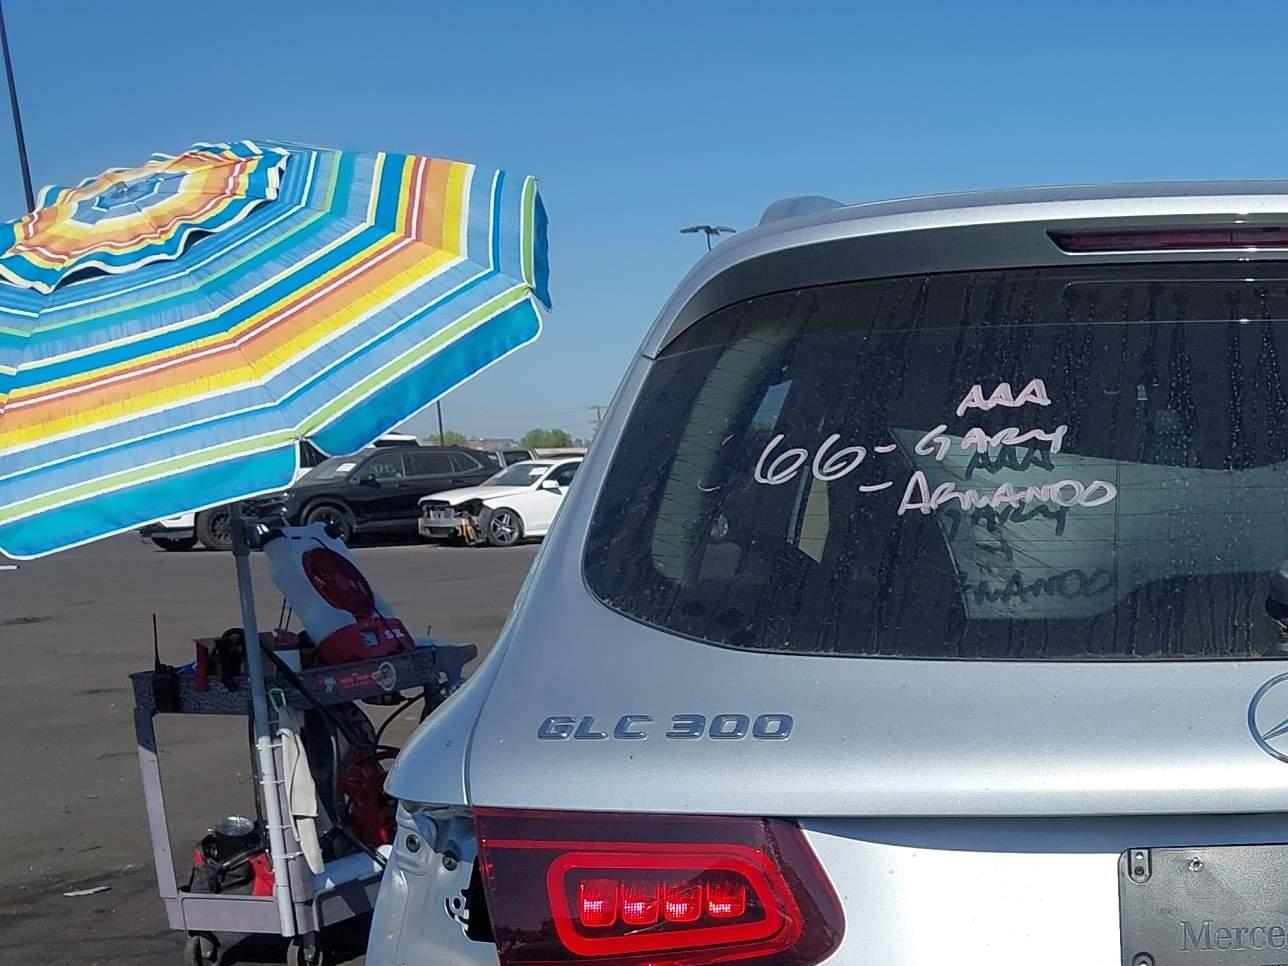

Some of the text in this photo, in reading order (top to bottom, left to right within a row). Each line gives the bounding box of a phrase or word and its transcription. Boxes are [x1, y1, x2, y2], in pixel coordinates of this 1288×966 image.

[956, 378, 1052, 416] AAA
[537, 713, 794, 740] GLC 300
